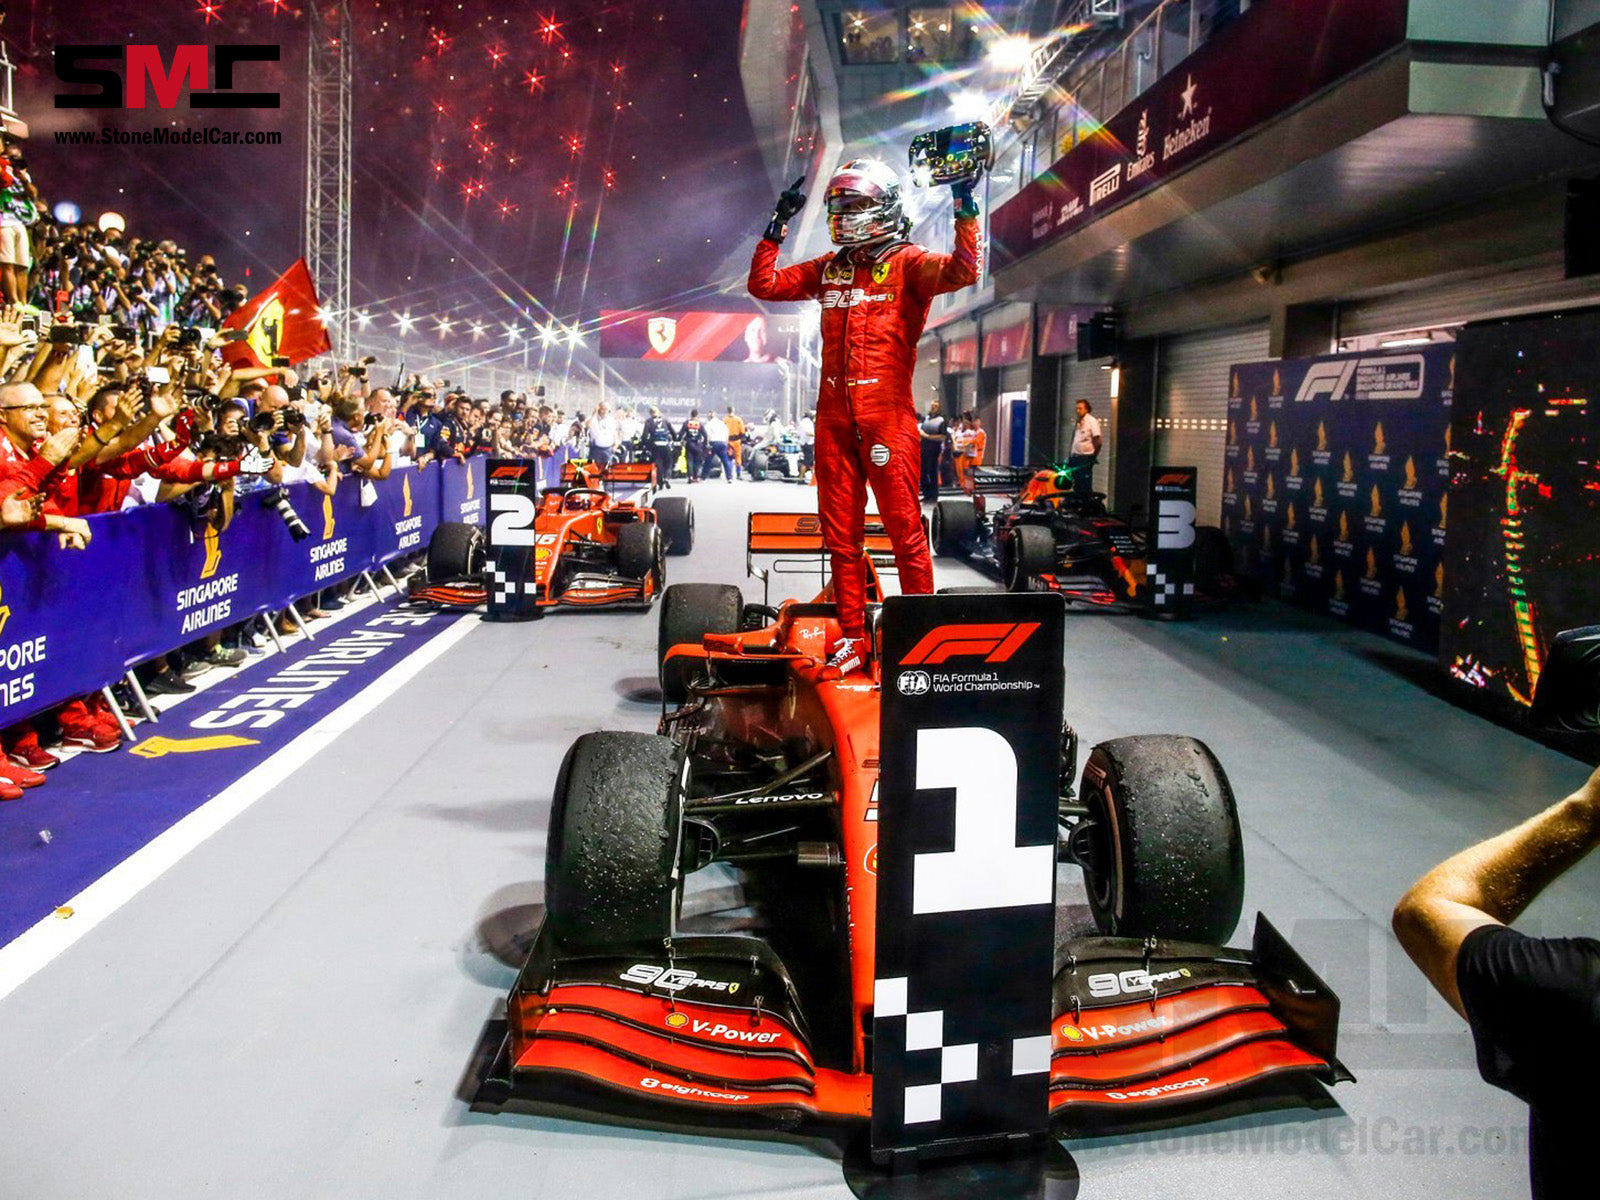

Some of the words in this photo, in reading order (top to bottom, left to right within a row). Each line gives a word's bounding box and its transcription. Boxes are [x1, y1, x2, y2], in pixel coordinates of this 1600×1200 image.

[1089, 163, 1121, 206] PIRELLI
[395, 515, 422, 535] SINGAPORE
[491, 493, 535, 546] 2
[1157, 500, 1196, 549] 3
[310, 537, 347, 563] SINGAPORE
[398, 531, 420, 550] AIRLINES
[314, 557, 344, 582] AIRLINES
[176, 572, 238, 611] SINGAPORE
[181, 598, 231, 634] AIRLINES
[899, 622, 1041, 665] F1
[189, 630, 406, 729] AIRLINES
[933, 673, 950, 683] FIA
[951, 672, 992, 682] Formula
[993, 672, 999, 681] 1
[933, 683, 962, 692] World
[735, 793, 823, 805] Lenovo
[912, 727, 1054, 915] 1
[692, 1019, 781, 1043] V-Power
[1082, 1016, 1167, 1041] V-Power
